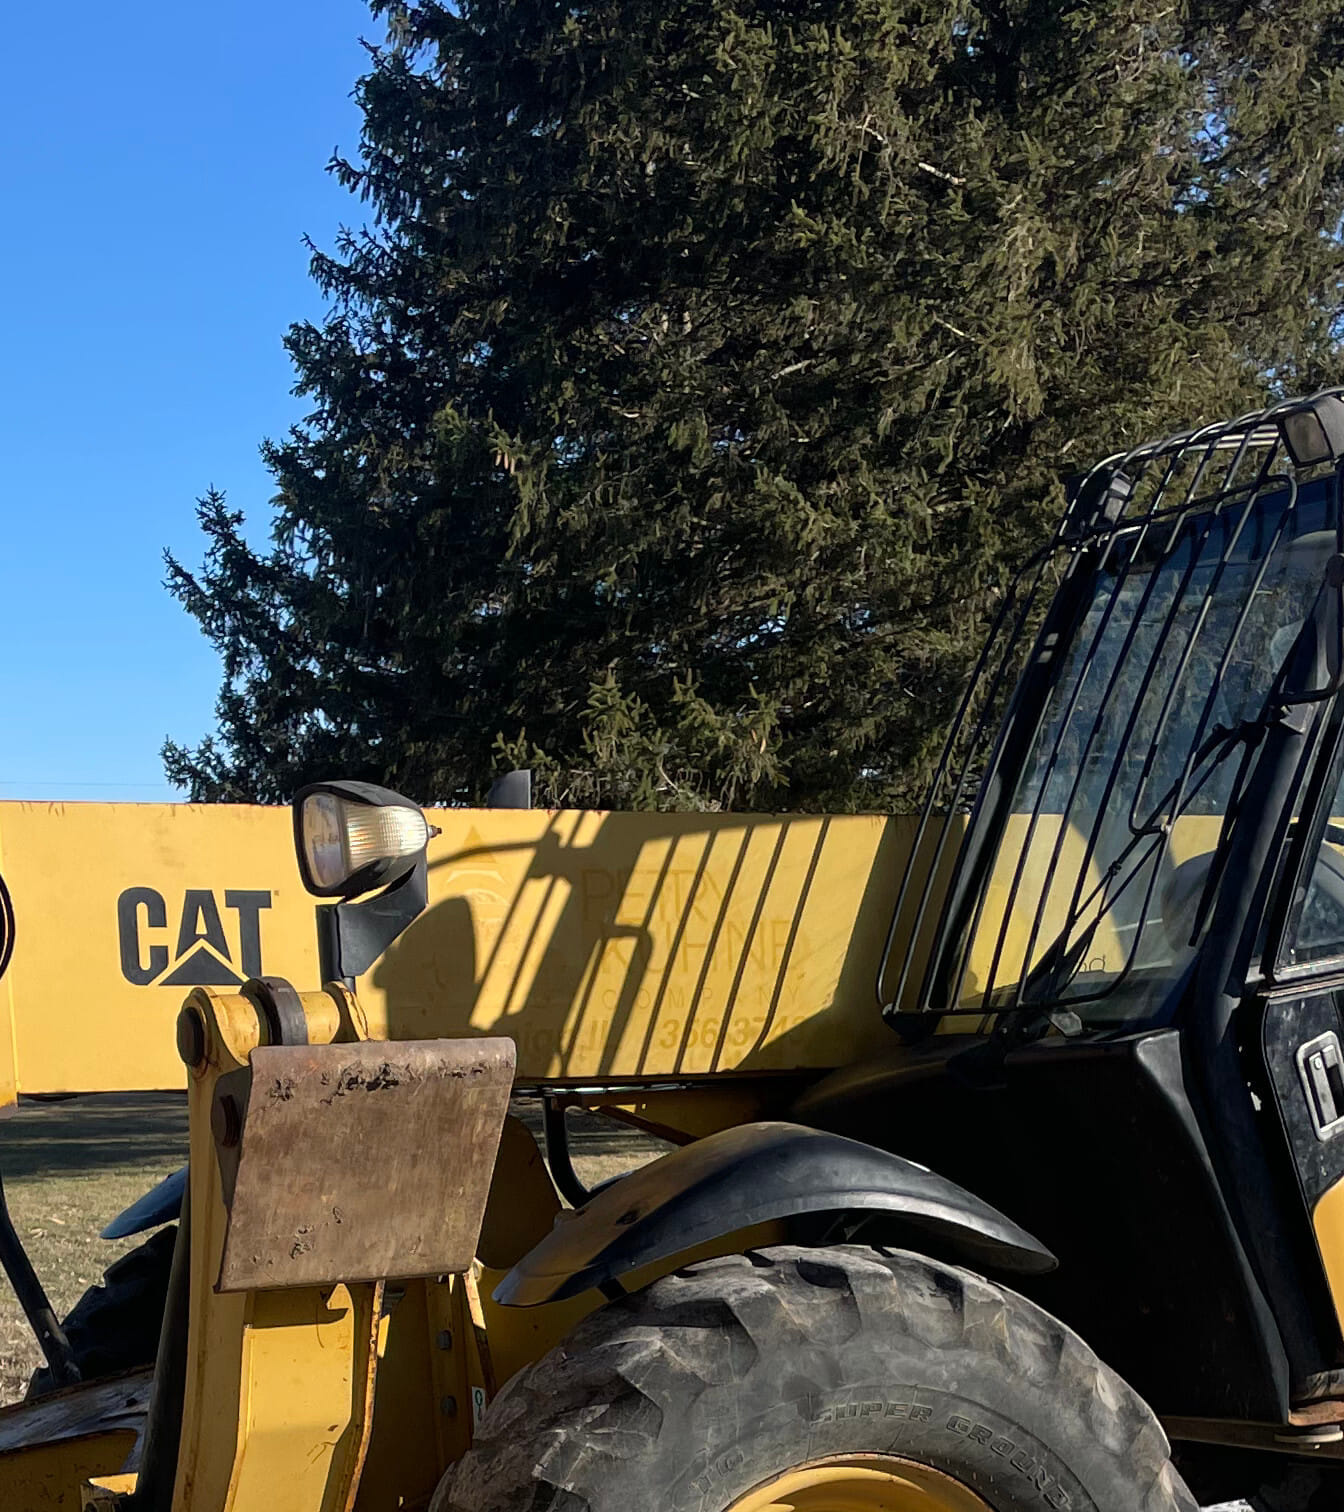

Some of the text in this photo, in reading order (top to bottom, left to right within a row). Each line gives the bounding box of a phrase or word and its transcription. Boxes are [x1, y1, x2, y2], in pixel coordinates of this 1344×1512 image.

[118, 886, 272, 986] CAT
[810, 1400, 933, 1426] SUPER
[946, 1413, 1071, 1510] GROUND
